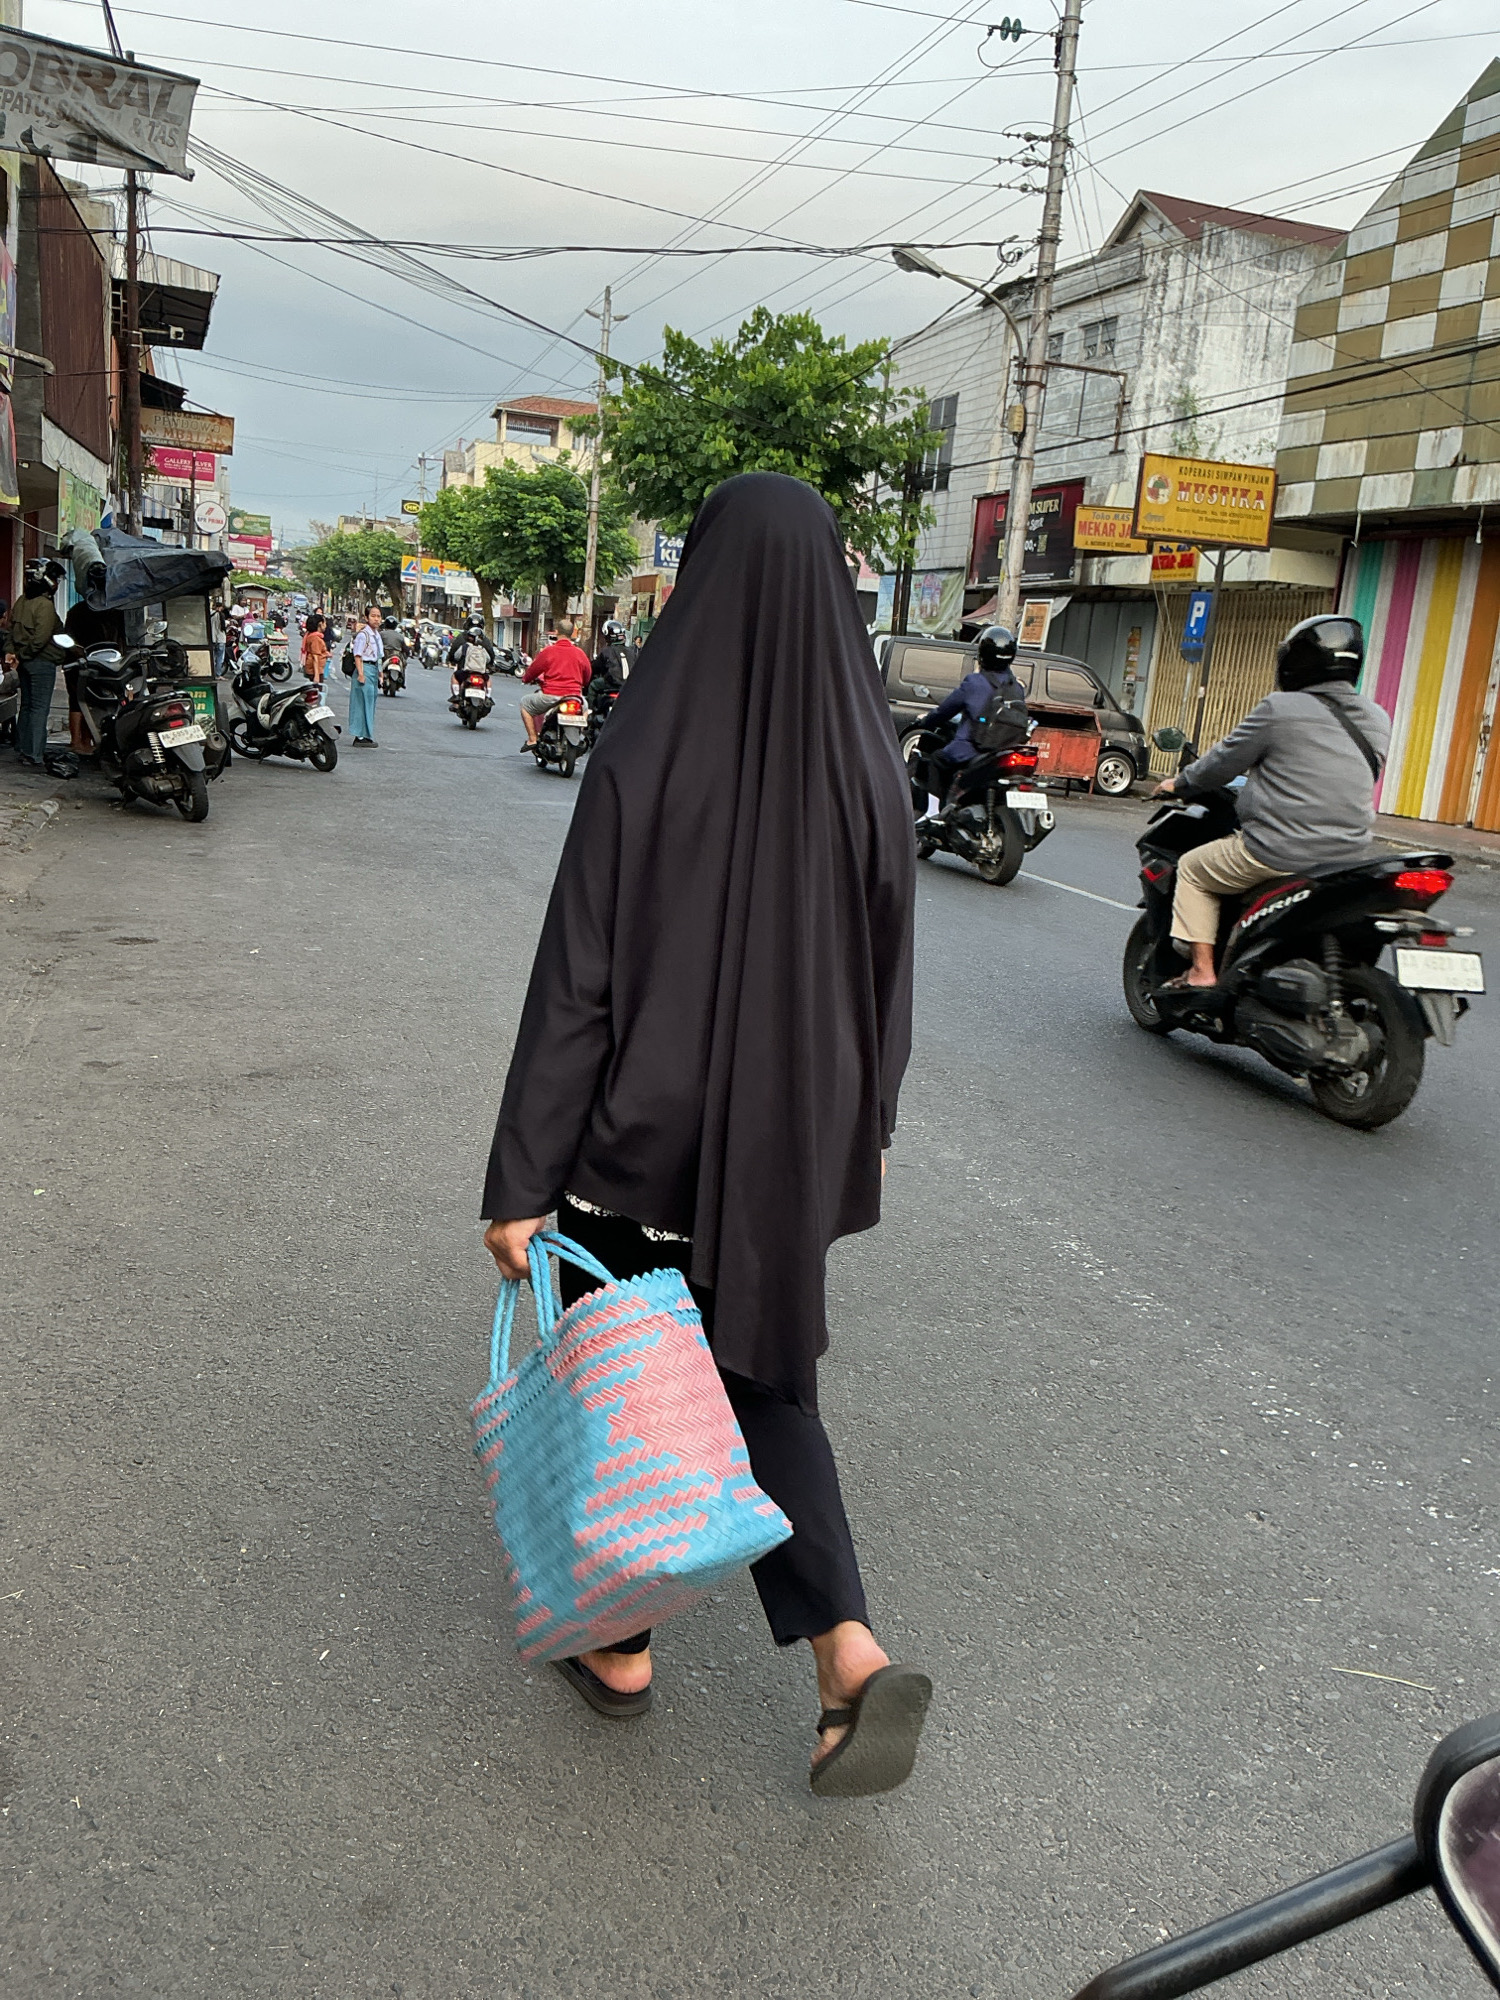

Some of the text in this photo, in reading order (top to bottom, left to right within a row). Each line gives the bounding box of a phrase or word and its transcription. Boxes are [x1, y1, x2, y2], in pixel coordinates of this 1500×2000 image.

[146, 120, 179, 149] TAS
[1179, 466, 1270, 485] KOPERASI SIMPAN PINJAM
[1035, 498, 1060, 515] SUPER
[1176, 480, 1266, 511] MUSTIKA
[1091, 511, 1131, 521] Toko MAS
[1078, 521, 1117, 538] MEKAR
[1189, 600, 1206, 628] P
[1241, 890, 1312, 928] VARIO
